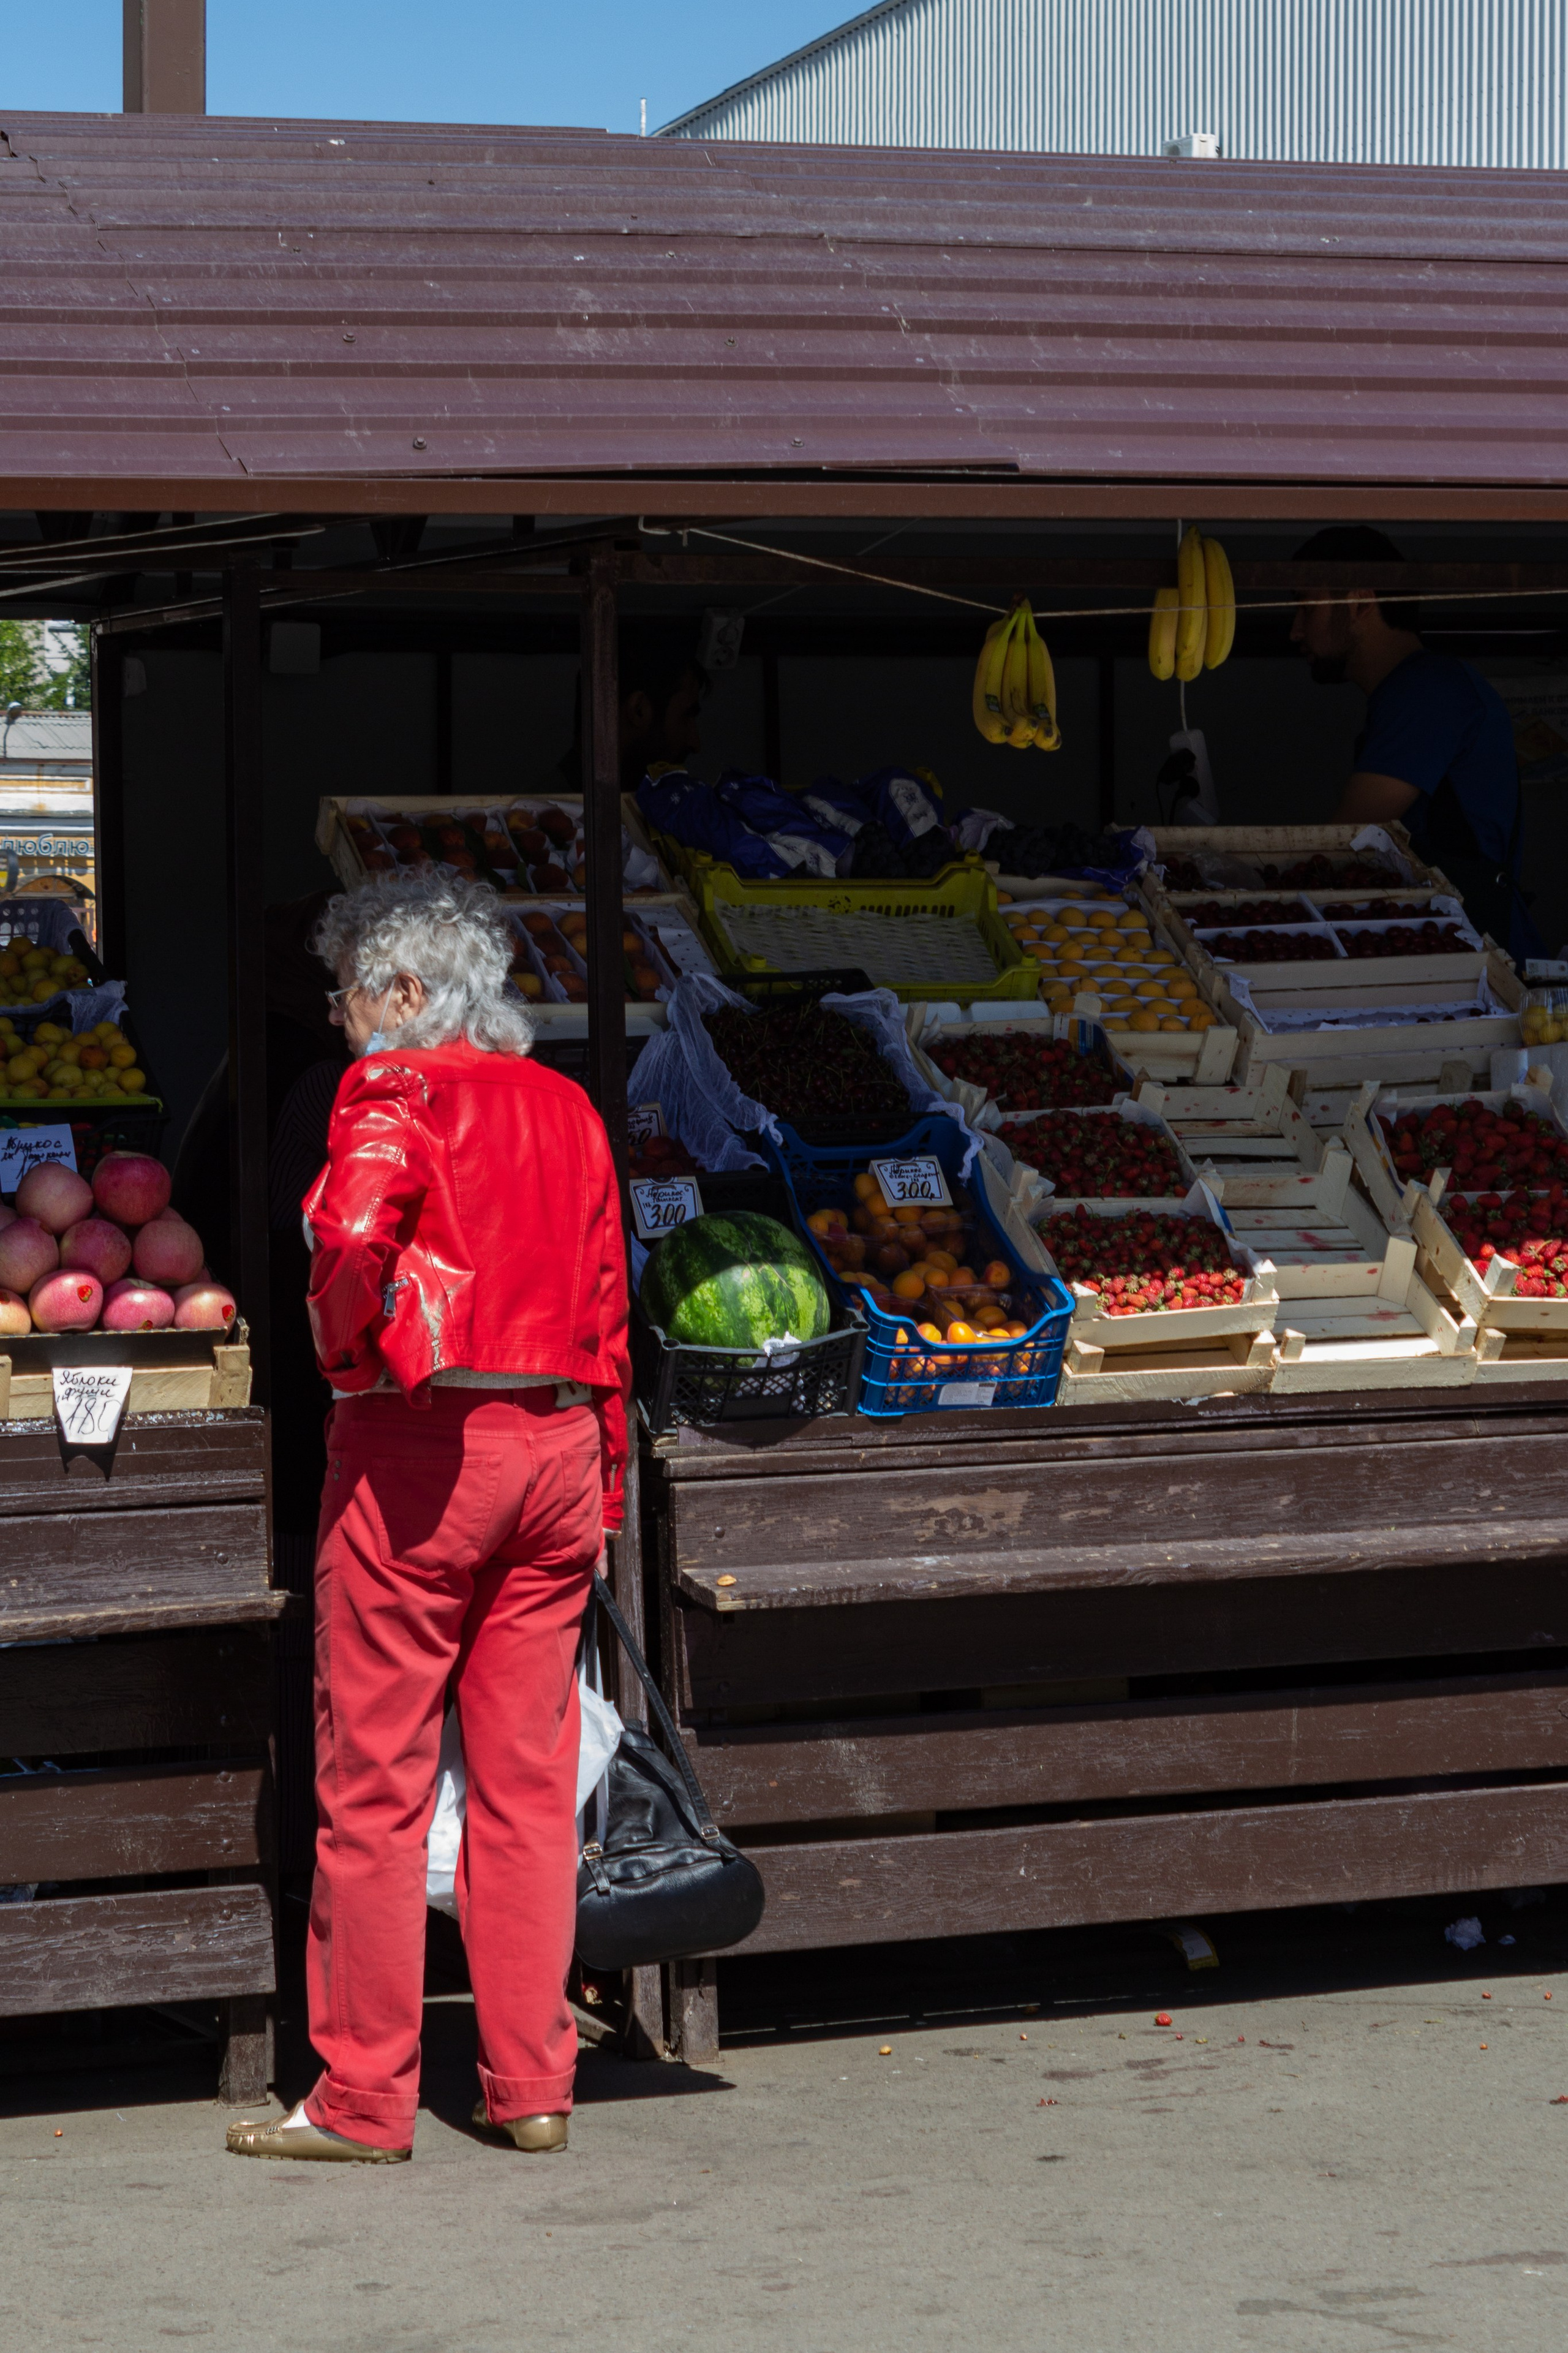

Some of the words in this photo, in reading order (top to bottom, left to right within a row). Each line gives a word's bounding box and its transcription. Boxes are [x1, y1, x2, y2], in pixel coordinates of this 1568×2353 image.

[1532, 707, 1568, 716] БАНКОВ
[650, 1203, 687, 1228] 300
[59, 1369, 119, 1386] Яблоки
[65, 1397, 122, 1435] 180
